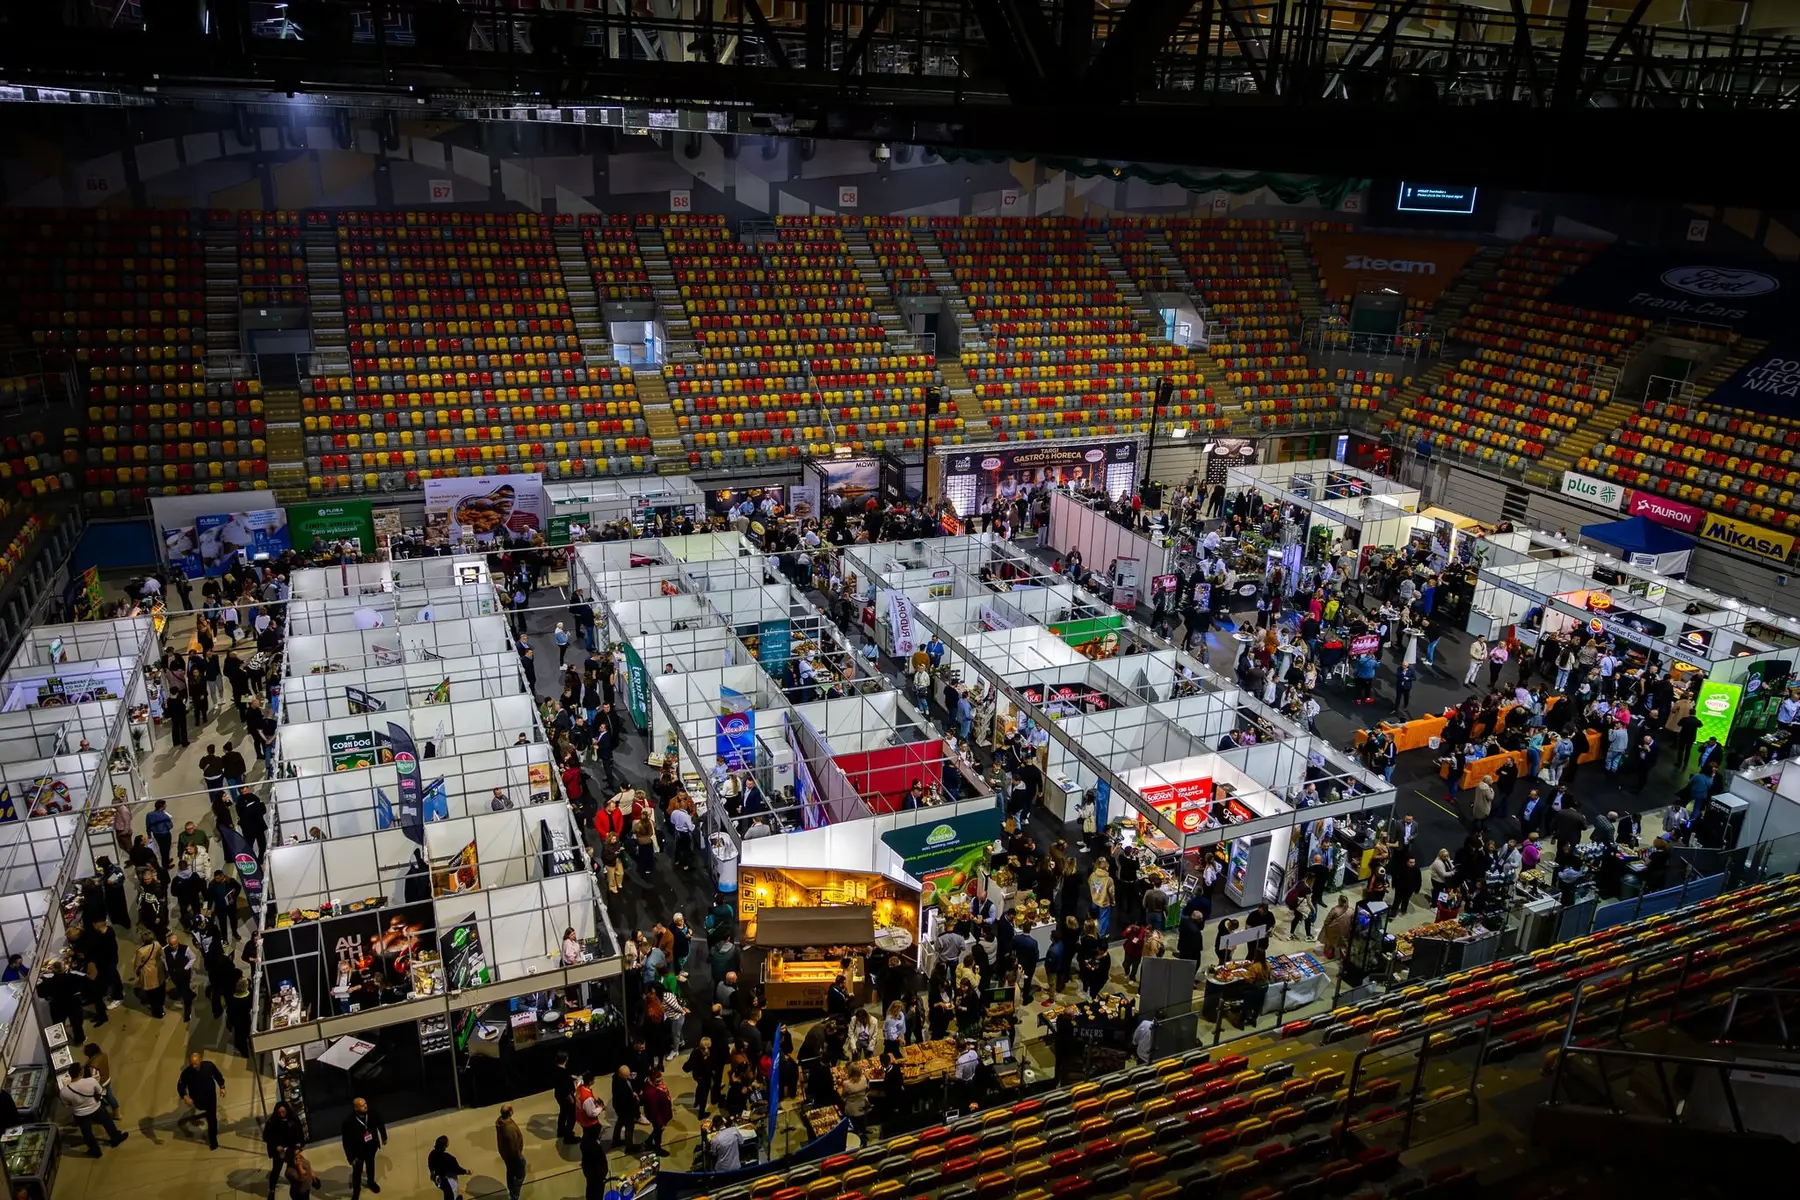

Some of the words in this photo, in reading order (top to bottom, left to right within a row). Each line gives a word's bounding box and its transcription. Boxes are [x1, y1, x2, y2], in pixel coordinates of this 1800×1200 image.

[87, 178, 108, 191] B6
[433, 187, 450, 198] B7
[842, 193, 856, 203] C8
[673, 197, 689, 207] B8
[1004, 196, 1016, 205] C7
[1215, 200, 1226, 209] C6
[1345, 200, 1358, 209] C5
[1691, 226, 1705, 238] C4
[1682, 269, 1757, 292] Ford
[1629, 292, 1750, 319] Frank-Cars
[1741, 378, 1799, 397] NIKA
[1013, 453, 1044, 463] GASTRO
[1051, 452, 1082, 460] HORECA
[1567, 477, 1597, 497] plus
[1649, 503, 1693, 524] TAURON
[1605, 624, 1626, 637] Koliber
[1626, 631, 1642, 643] Food
[1674, 650, 1694, 662] RITPOL
[332, 742, 353, 750] CORN
[354, 739, 372, 747] DOG
[929, 834, 955, 843] PURENA
[335, 934, 362, 952] AU
[336, 946, 364, 964] TH
[1073, 1027, 1104, 1039] PCKERS
